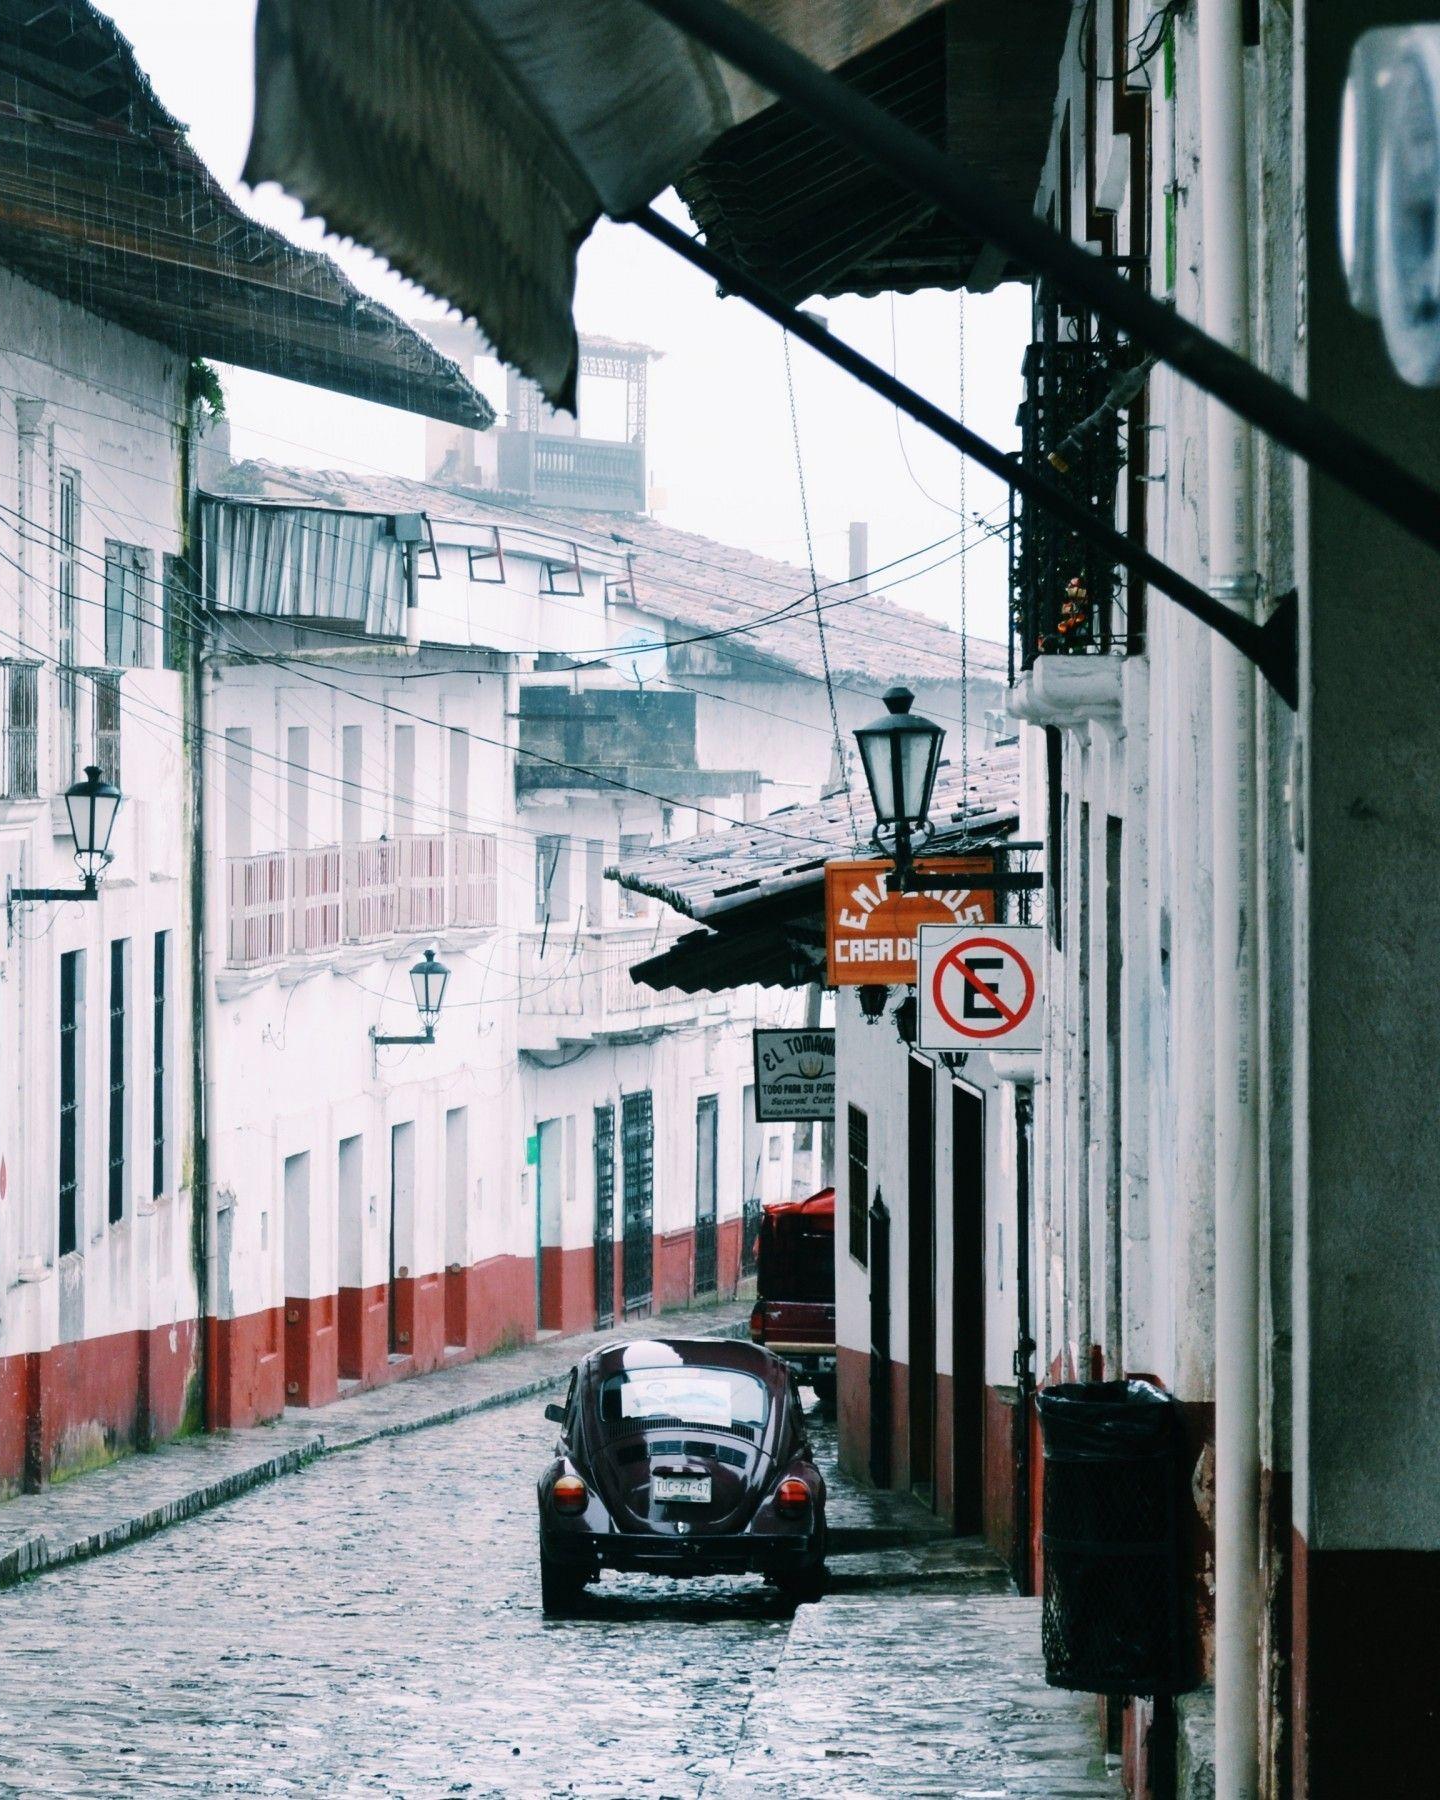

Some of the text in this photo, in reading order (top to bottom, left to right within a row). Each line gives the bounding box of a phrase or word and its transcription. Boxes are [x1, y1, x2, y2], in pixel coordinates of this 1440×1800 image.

[838, 868, 986, 931] EMUS
[834, 938, 894, 963] CASA
[963, 958, 1004, 1019] E
[763, 1034, 836, 1072] EL TOMAQU
[761, 1084, 783, 1095] TODO
[784, 1083, 801, 1094] PARA
[803, 1083, 814, 1094] SU
